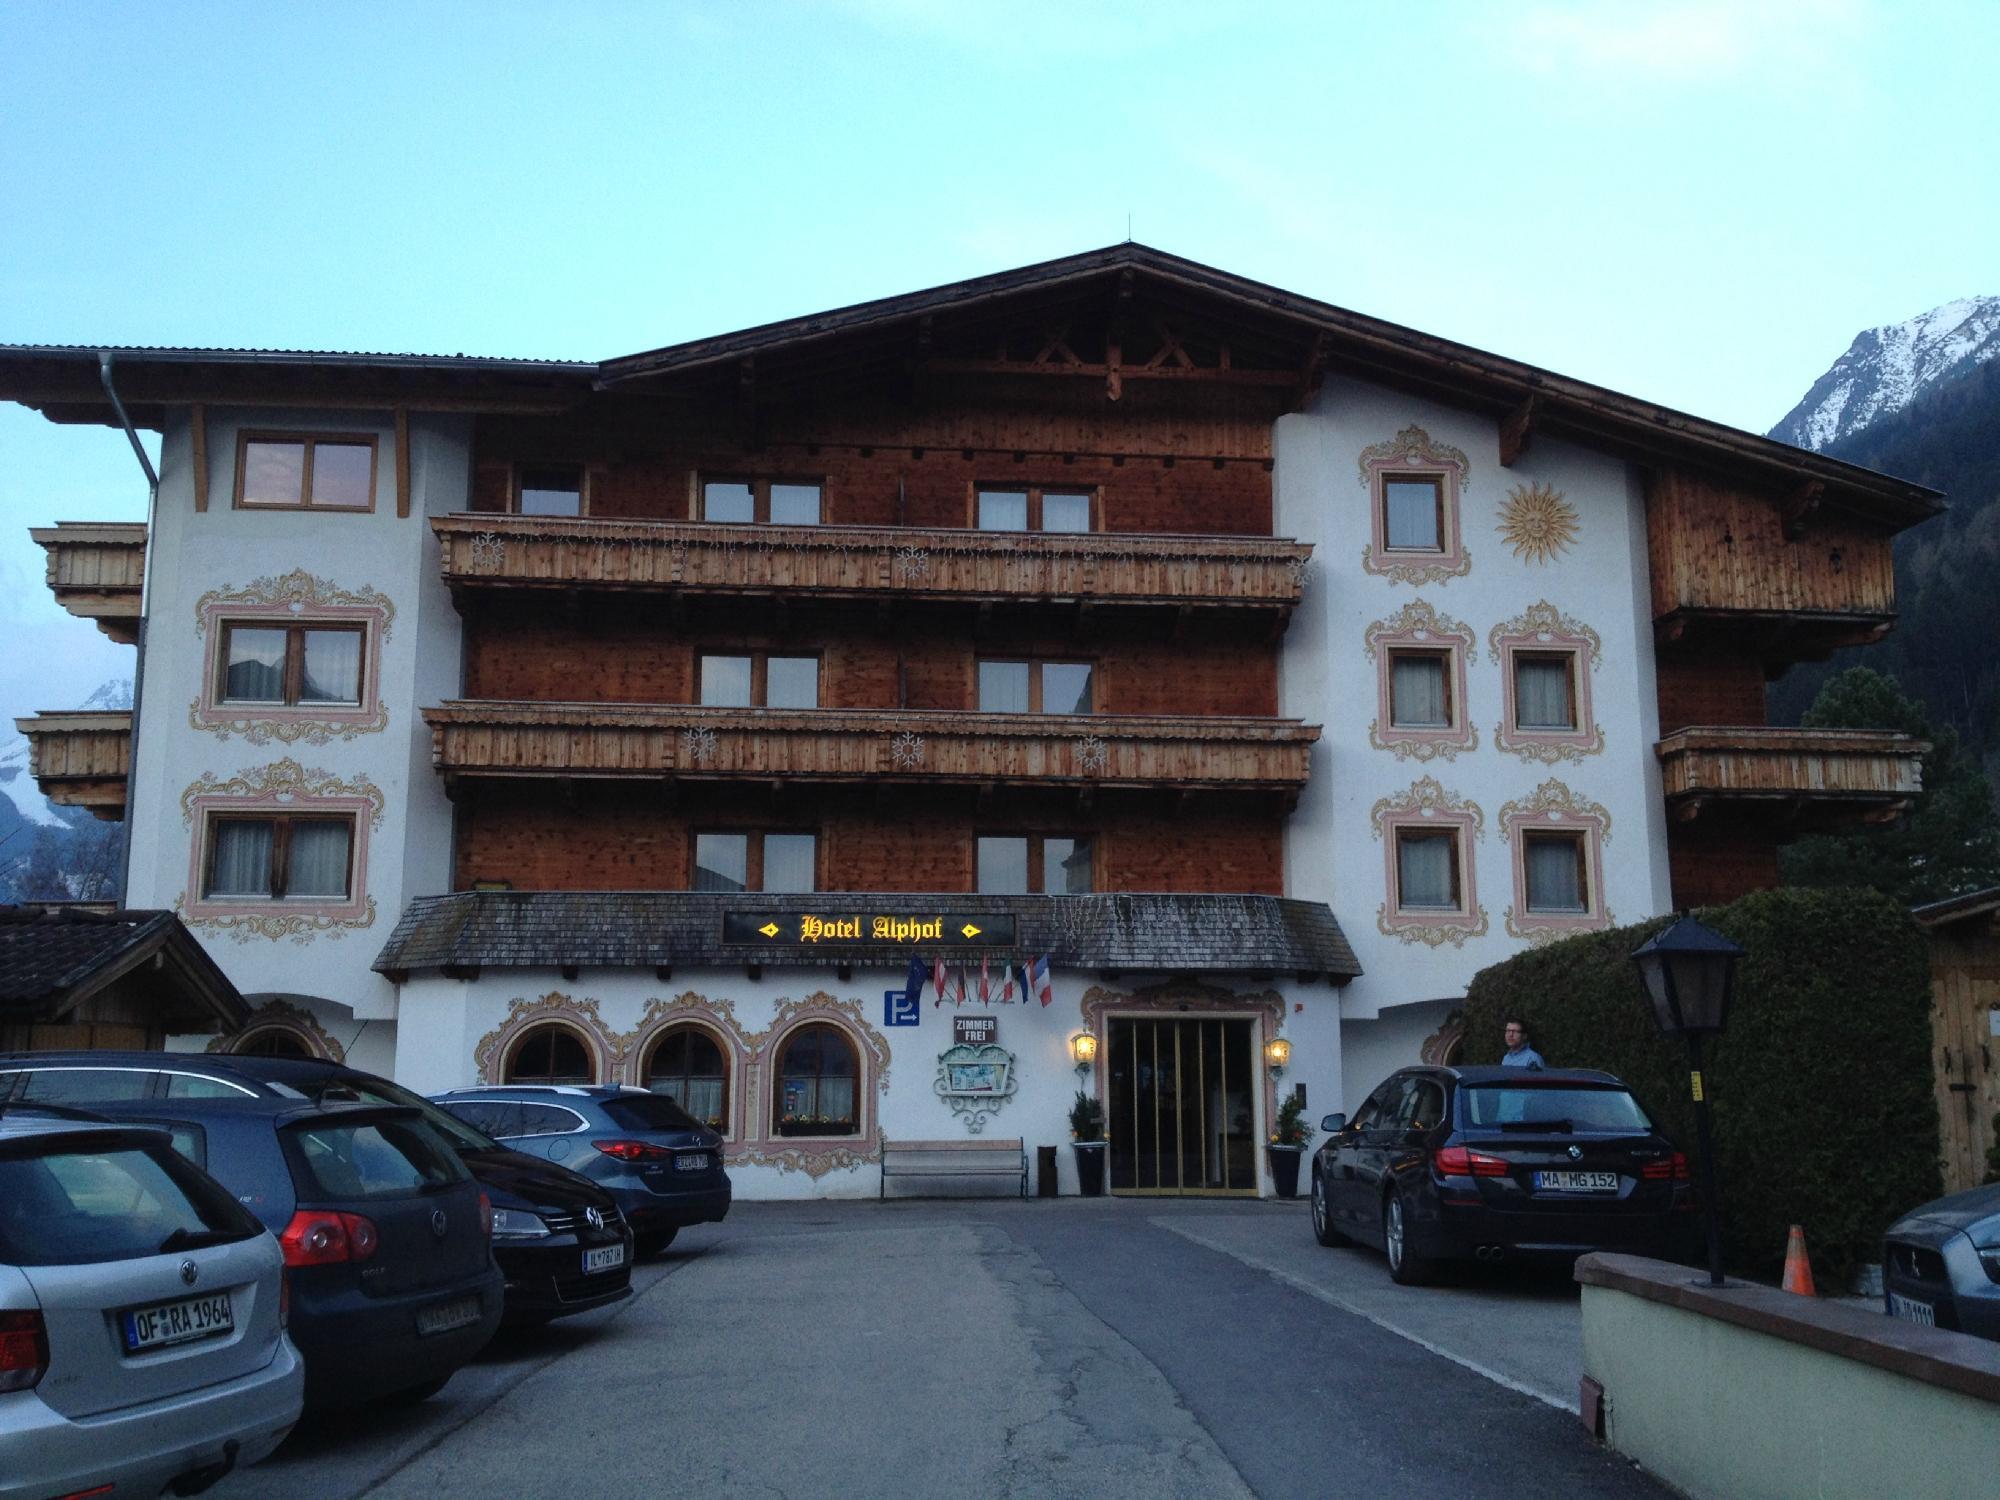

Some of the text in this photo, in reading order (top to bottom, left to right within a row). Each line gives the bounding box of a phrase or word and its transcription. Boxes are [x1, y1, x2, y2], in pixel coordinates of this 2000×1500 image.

[801, 914, 943, 943] Hotel Alphof
[891, 993, 913, 1024] P
[956, 1020, 994, 1031] ZIMMER
[965, 1030, 986, 1041] FREI
[1541, 1172, 1616, 1188] MA MG 152
[137, 1298, 230, 1341] OF RA 1964
